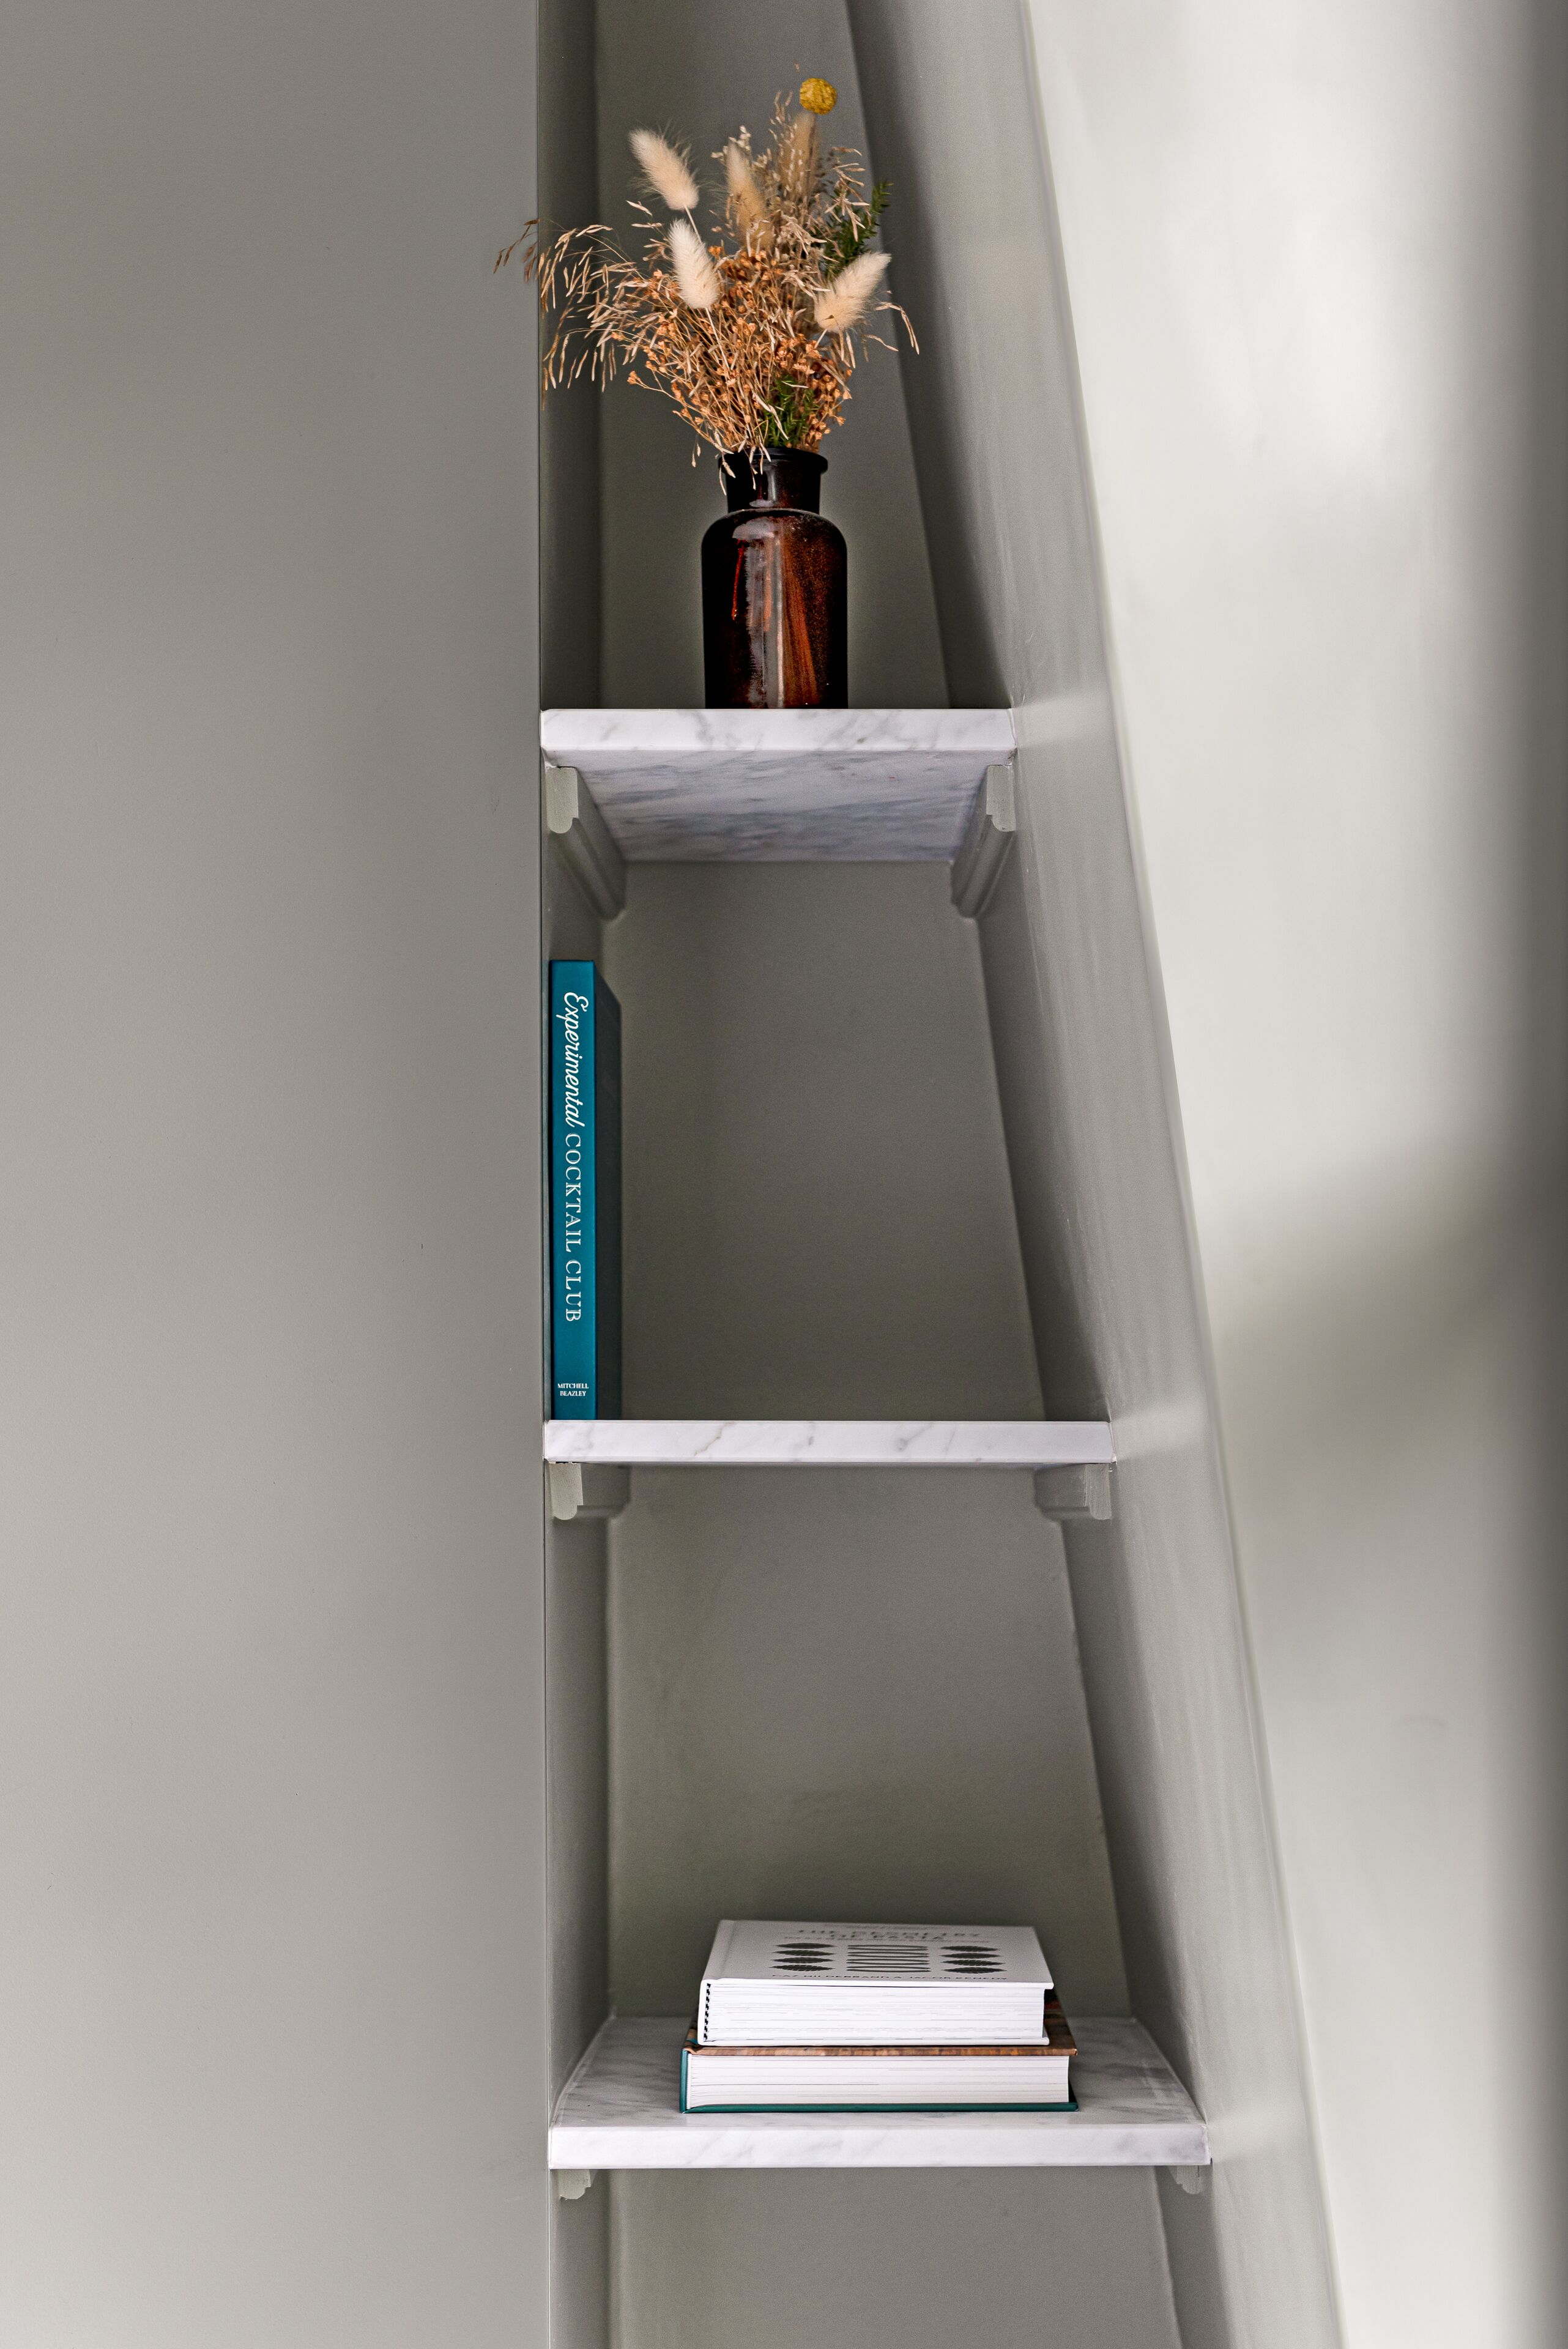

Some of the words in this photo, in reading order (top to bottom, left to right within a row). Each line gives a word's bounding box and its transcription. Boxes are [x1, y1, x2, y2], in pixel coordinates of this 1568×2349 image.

[555, 992, 589, 1127] Experimental
[565, 1134, 581, 1252] COCKTAIL
[565, 1260, 581, 1322] CLUB
